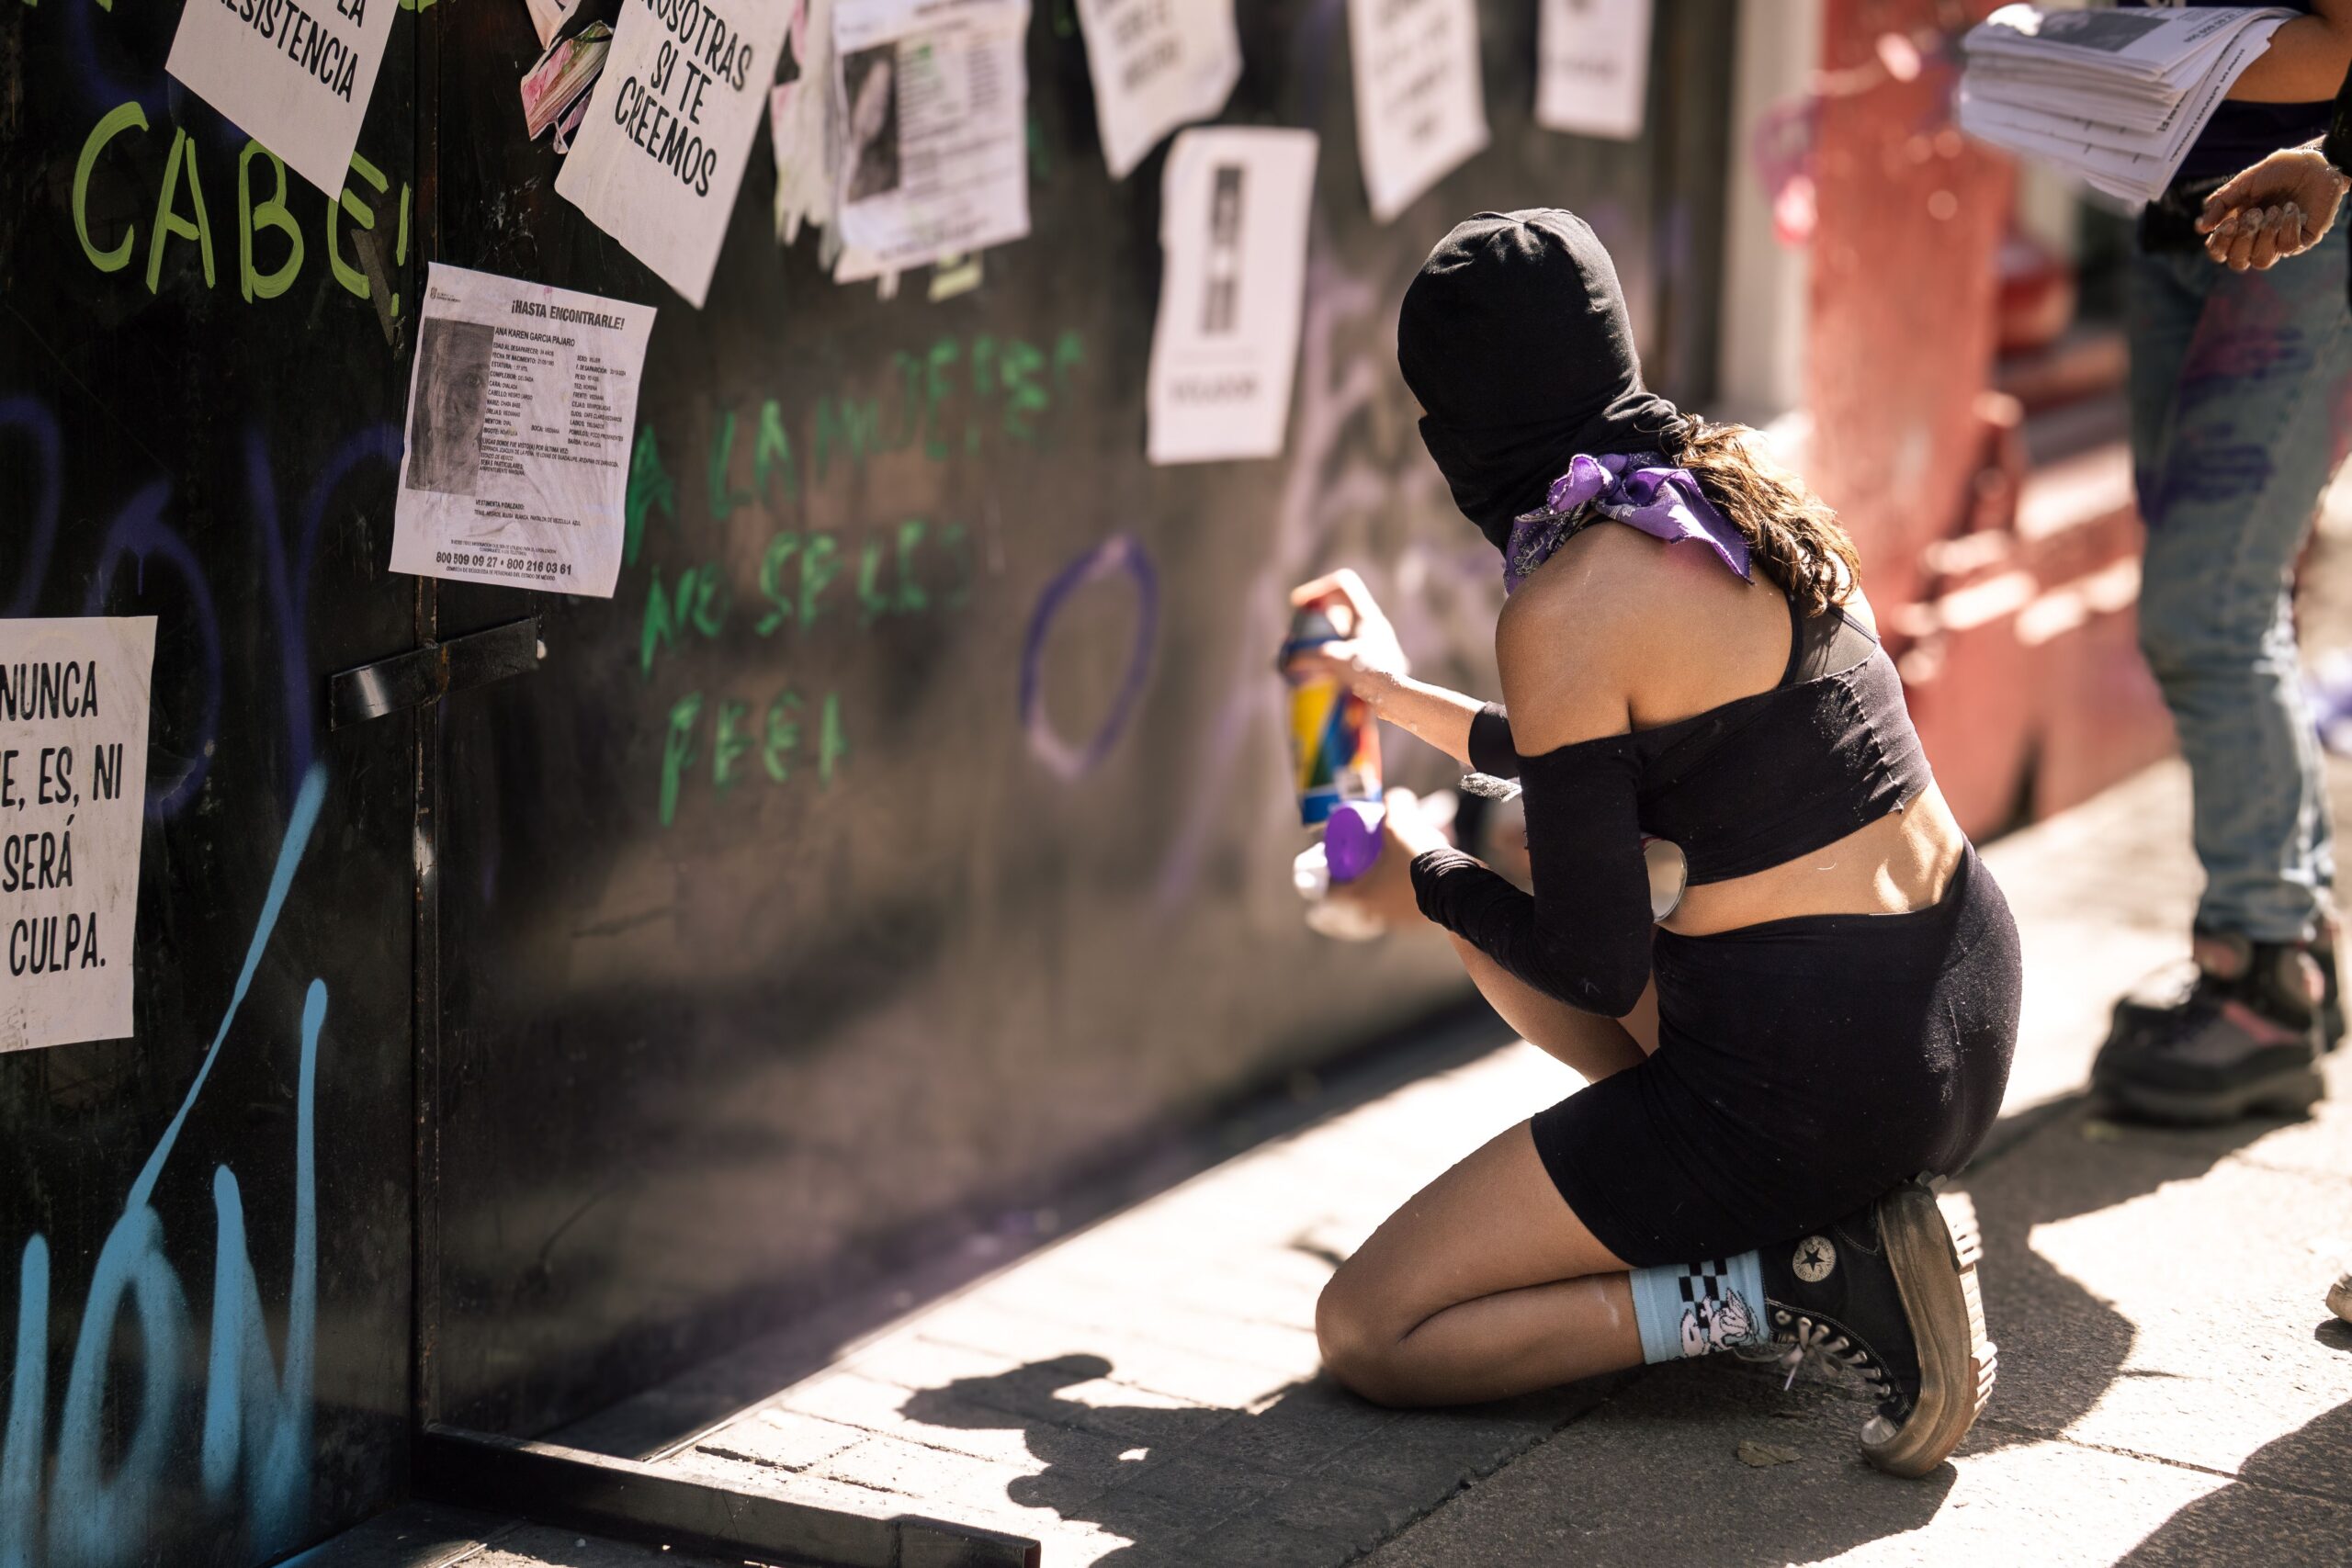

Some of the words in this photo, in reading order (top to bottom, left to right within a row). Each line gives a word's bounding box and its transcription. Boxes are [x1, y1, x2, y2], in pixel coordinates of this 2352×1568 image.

[221, 0, 358, 103] SISTENCIA
[641, 0, 753, 92] SOTRAS
[650, 39, 679, 96] SI
[679, 61, 712, 125] TE
[615, 76, 718, 197] CREEMOS
[494, 326, 507, 336] ANA
[507, 329, 529, 340] KAREN
[551, 335, 575, 346] PAJARO
[511, 299, 547, 319] ¡HASTA
[550, 305, 626, 331] ENCONTRARLE!
[435, 550, 452, 564] 800
[452, 552, 469, 565] 509
[471, 554, 484, 567] 09
[485, 555, 497, 568] 27
[506, 558, 524, 570] 800
[526, 559, 544, 572] 216
[545, 561, 558, 573] 03
[559, 562, 571, 575] 61
[0, 660, 98, 721] NUNCA
[0, 750, 26, 811] E,
[38, 746, 80, 807] ES,
[93, 743, 124, 801] NI
[2, 814, 75, 893] SERÁ
[9, 912, 107, 977] CULPA.
